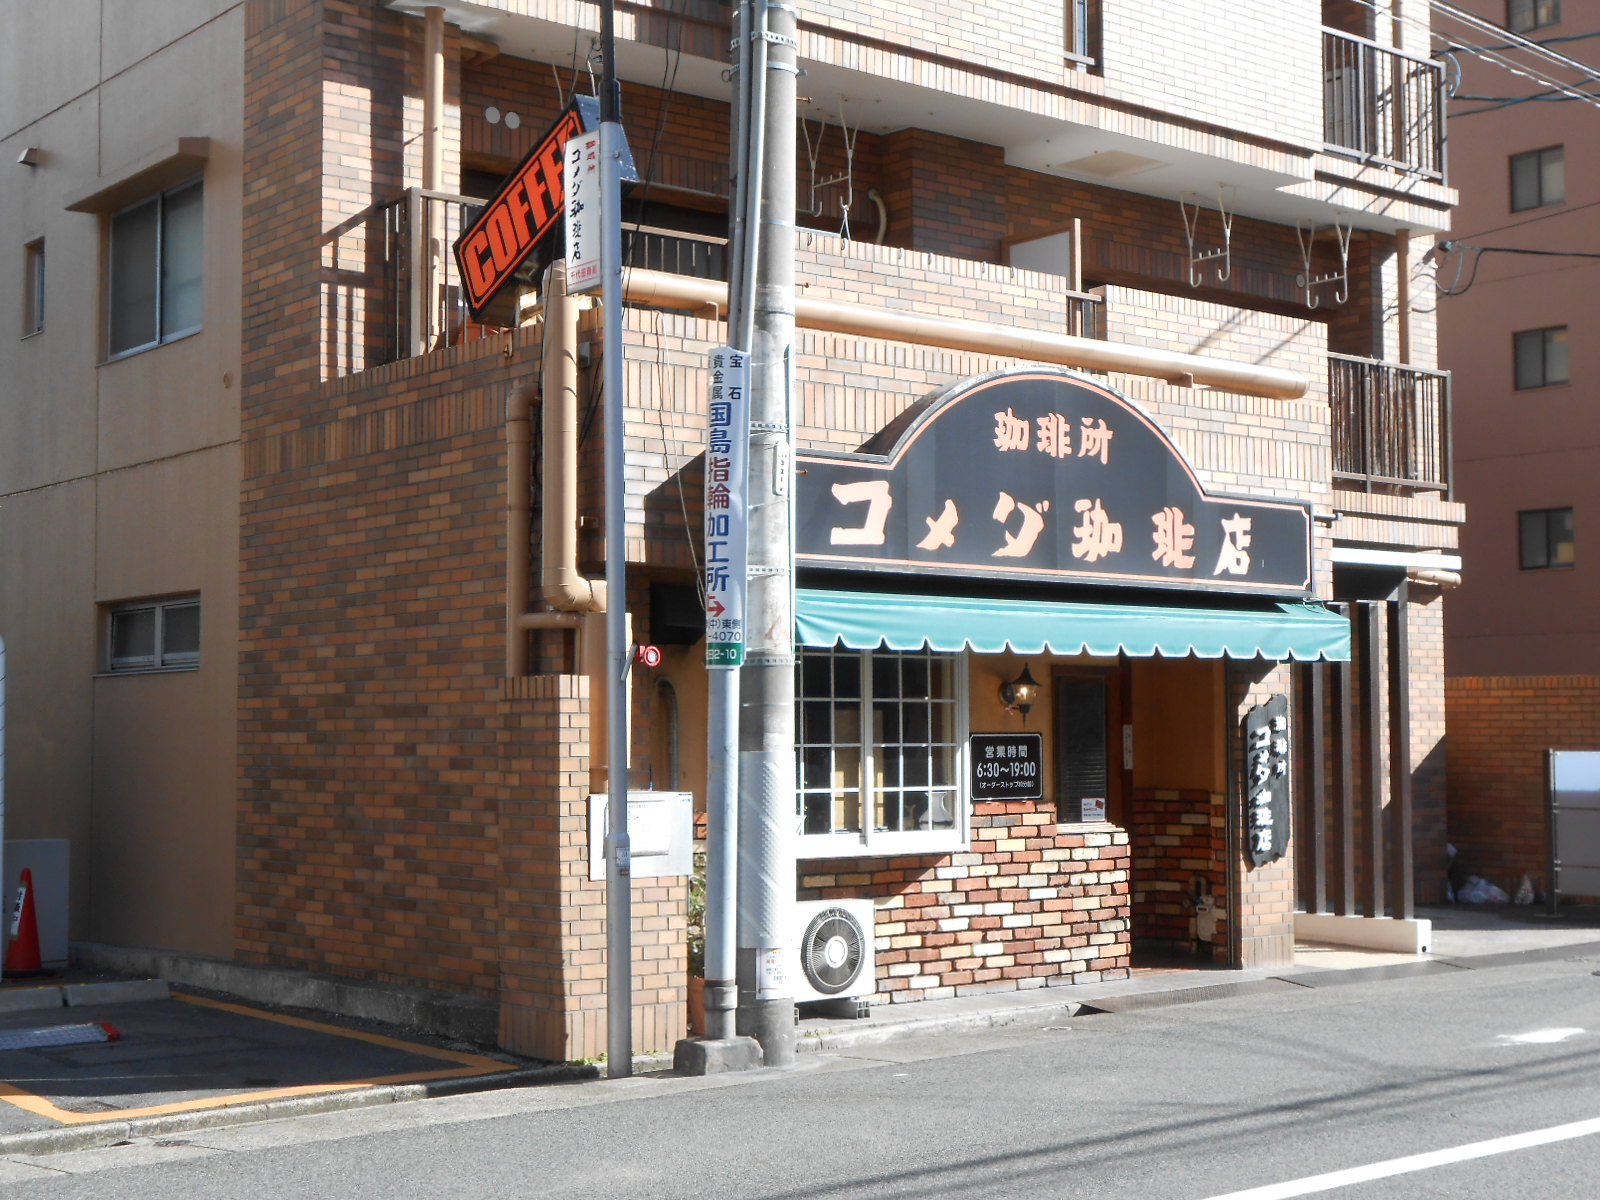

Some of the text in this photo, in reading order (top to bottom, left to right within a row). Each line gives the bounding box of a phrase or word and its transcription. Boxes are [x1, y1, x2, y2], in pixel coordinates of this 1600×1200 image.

[728, 354, 744, 400] 宝石
[992, 407, 1114, 465] 珈琲所
[706, 401, 732, 592] 国島指輪加工所
[830, 480, 1253, 577] コメダ珈琲店
[985, 745, 1028, 759] 営業時間
